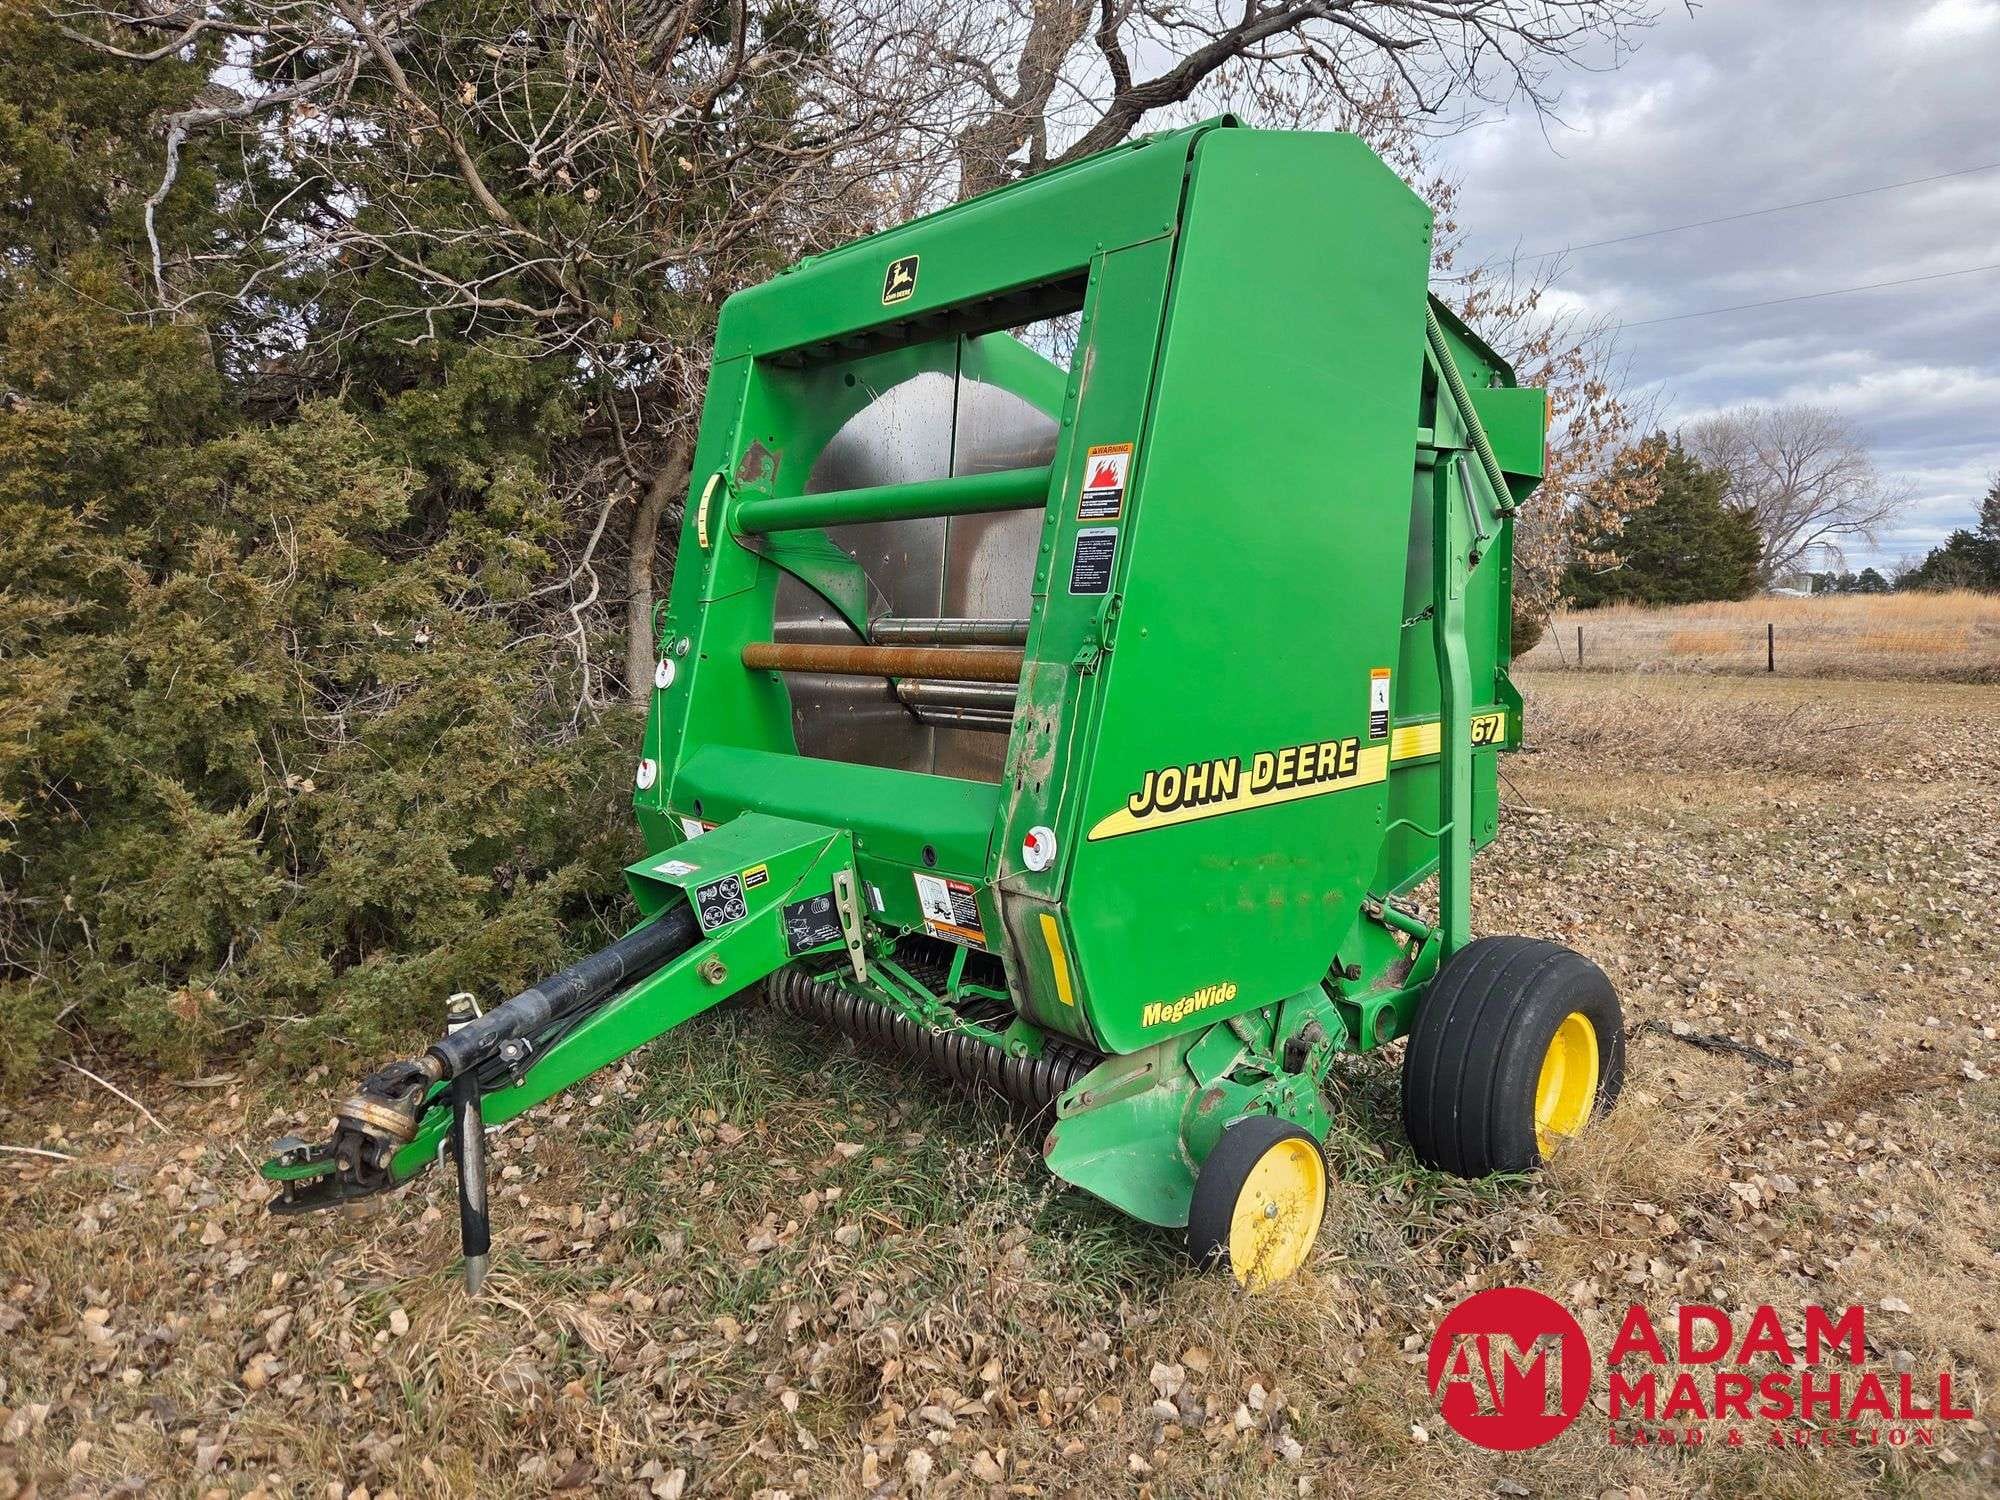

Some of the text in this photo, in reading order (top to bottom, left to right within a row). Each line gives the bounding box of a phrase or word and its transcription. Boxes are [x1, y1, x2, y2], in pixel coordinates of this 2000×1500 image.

[1097, 444, 1129, 454] WARNING
[1471, 715, 1498, 745] 67
[1128, 736, 1360, 817] JOHN DEERE
[1142, 982, 1238, 1028] MegaWide
